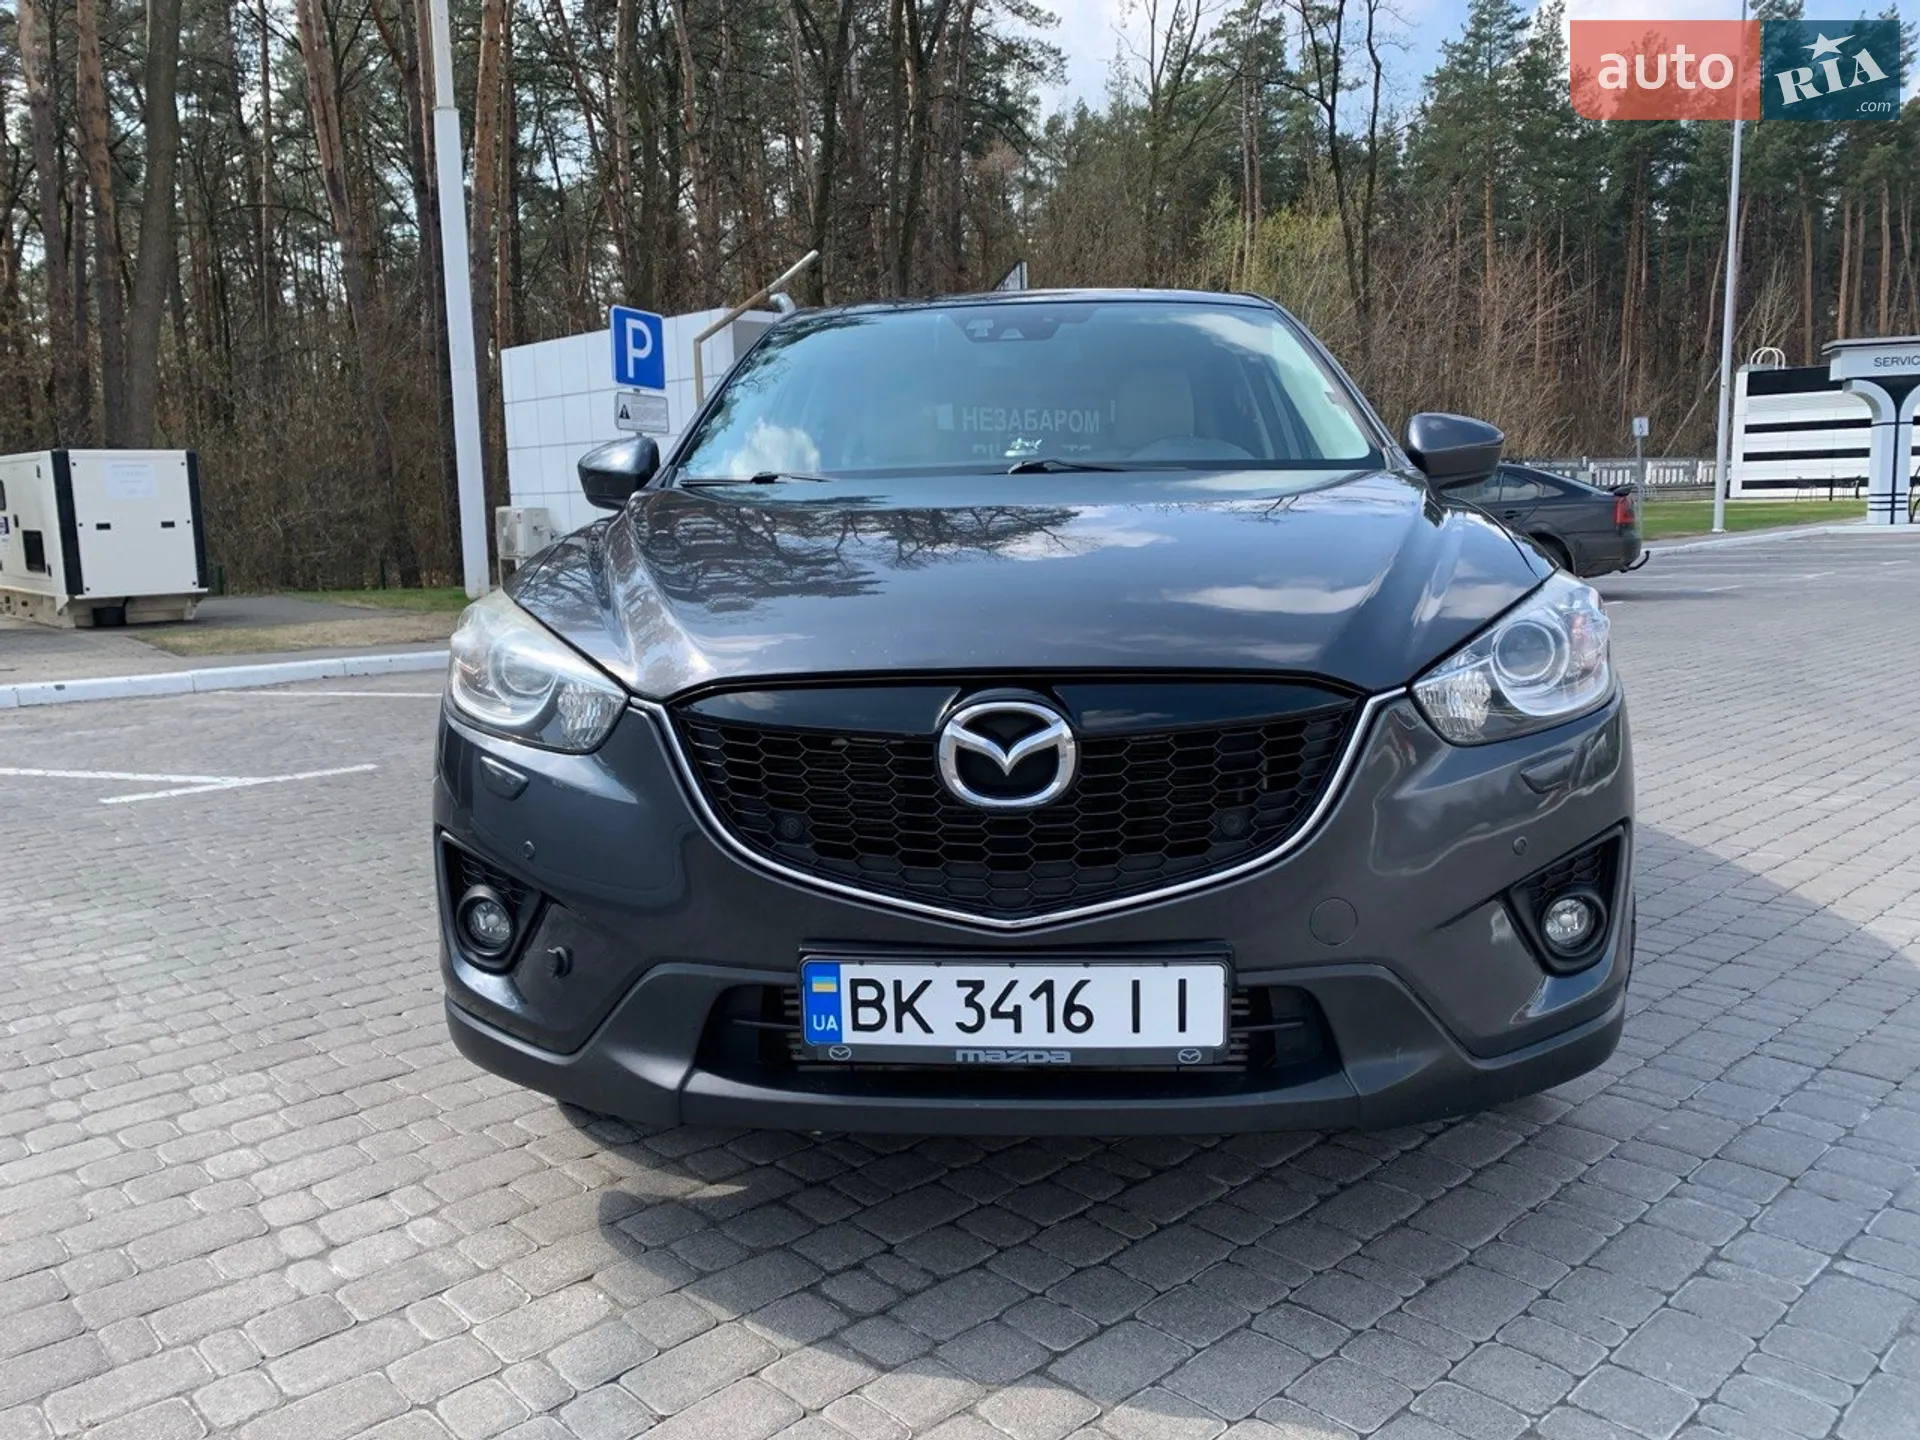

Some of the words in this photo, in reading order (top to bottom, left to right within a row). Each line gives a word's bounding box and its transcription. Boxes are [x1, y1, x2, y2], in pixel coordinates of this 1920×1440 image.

[626, 318, 653, 379] P
[962, 407, 1100, 433] НЕЗАБАРОМ
[813, 1014, 839, 1032] UA
[849, 978, 935, 1034] BK
[955, 979, 1094, 1034] 3416
